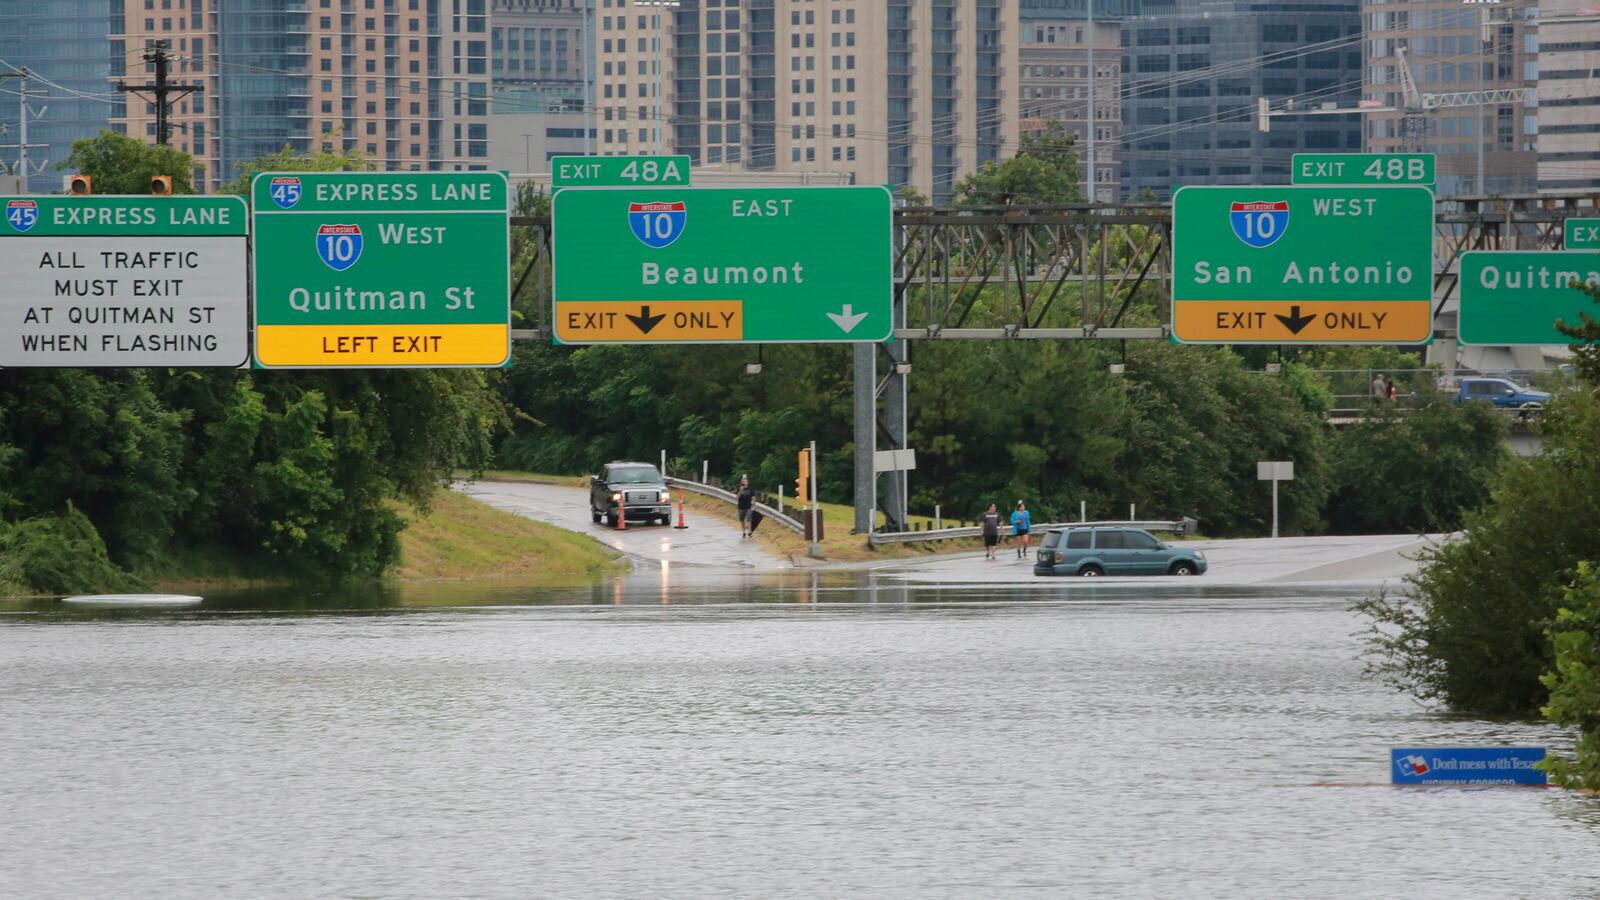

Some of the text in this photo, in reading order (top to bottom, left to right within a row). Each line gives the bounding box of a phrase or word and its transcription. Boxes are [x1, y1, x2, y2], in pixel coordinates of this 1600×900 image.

[559, 160, 682, 182] EXIT 48A
[1302, 158, 1425, 180] EXIT 48B
[272, 183, 491, 203] 45 EXPRESS LANE
[9, 207, 230, 226] 45 EXPRESS LANE
[732, 199, 793, 217] EAST
[1313, 198, 1377, 217] WEST
[642, 212, 674, 240] 10
[1243, 212, 1276, 239] 10
[325, 235, 354, 262] 10
[39, 251, 199, 269] ALL TRAFFIC
[642, 262, 804, 285] Beaumont
[1193, 260, 1413, 284] San Antonio
[55, 279, 184, 297] MUST EXIT
[289, 285, 475, 313] Quitman St
[23, 306, 216, 325] AT QUITMAN ST
[568, 311, 736, 329] EXIT ONLY
[1216, 311, 1388, 329] EXIT ONLY
[21, 334, 218, 352] WHEN FLASHING
[322, 335, 443, 354] LEFT EXIT
[1459, 759, 1486, 770] mess
[1487, 757, 1511, 770] with
